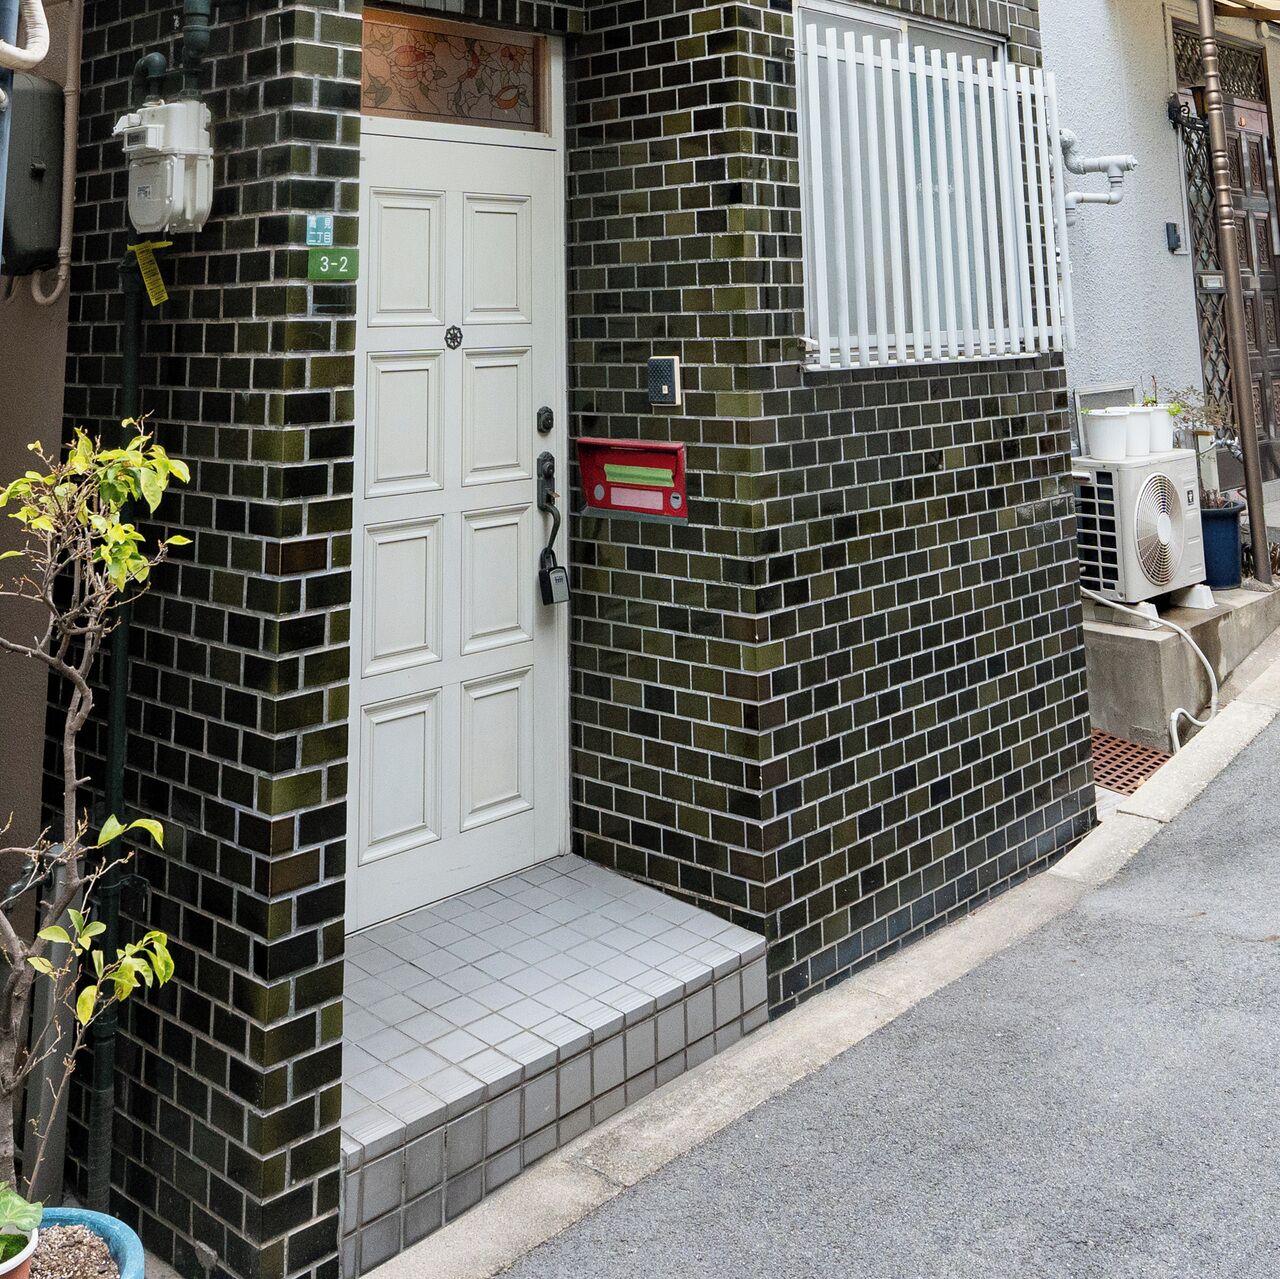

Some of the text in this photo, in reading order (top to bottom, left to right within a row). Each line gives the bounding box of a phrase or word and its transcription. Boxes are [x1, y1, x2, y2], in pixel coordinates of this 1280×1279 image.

[308, 231, 331, 243] 二丁目
[320, 255, 348, 272] 3-2
